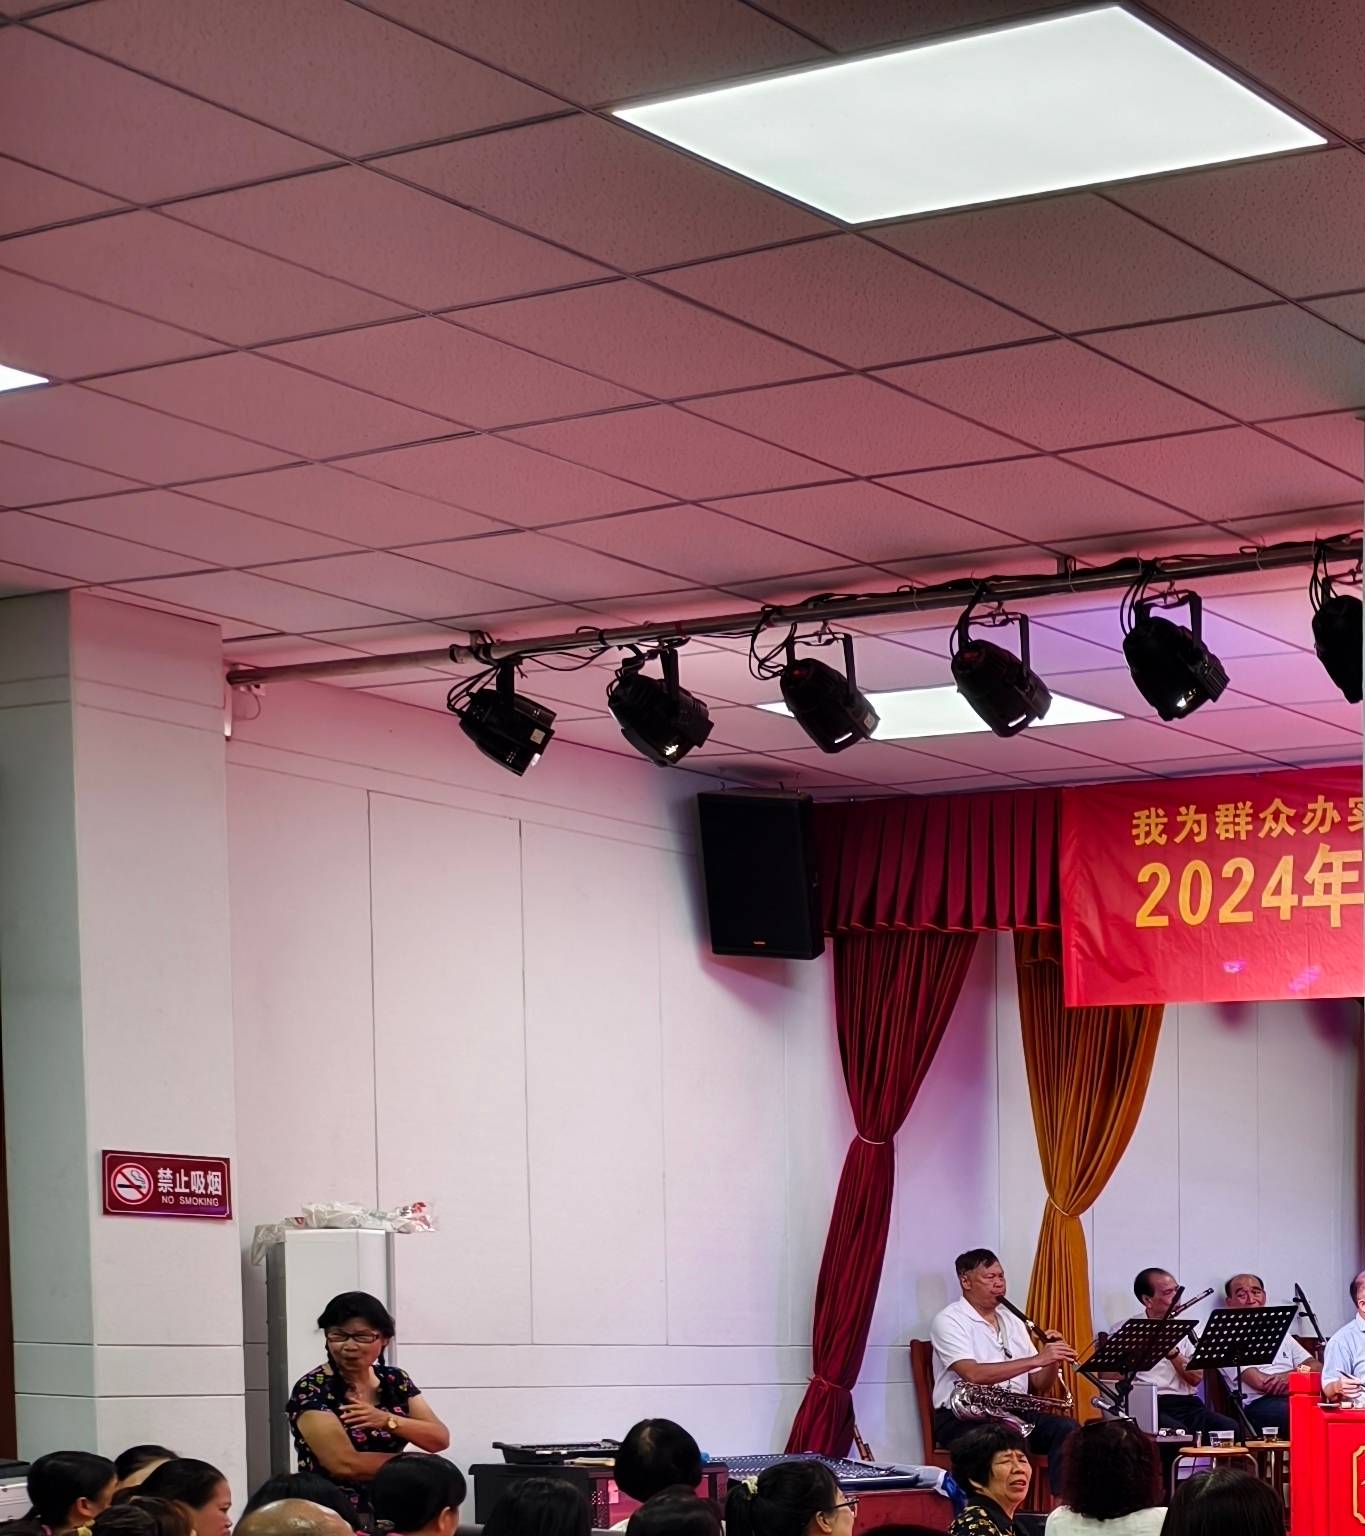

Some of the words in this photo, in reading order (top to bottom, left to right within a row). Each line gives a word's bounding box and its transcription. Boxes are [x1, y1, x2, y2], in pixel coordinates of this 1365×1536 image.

[1136, 842, 1364, 928] 2024年
[158, 1168, 222, 1196] 禁止吸烟
[162, 1195, 174, 1204] NO
[180, 1197, 219, 1207] SMOKING
